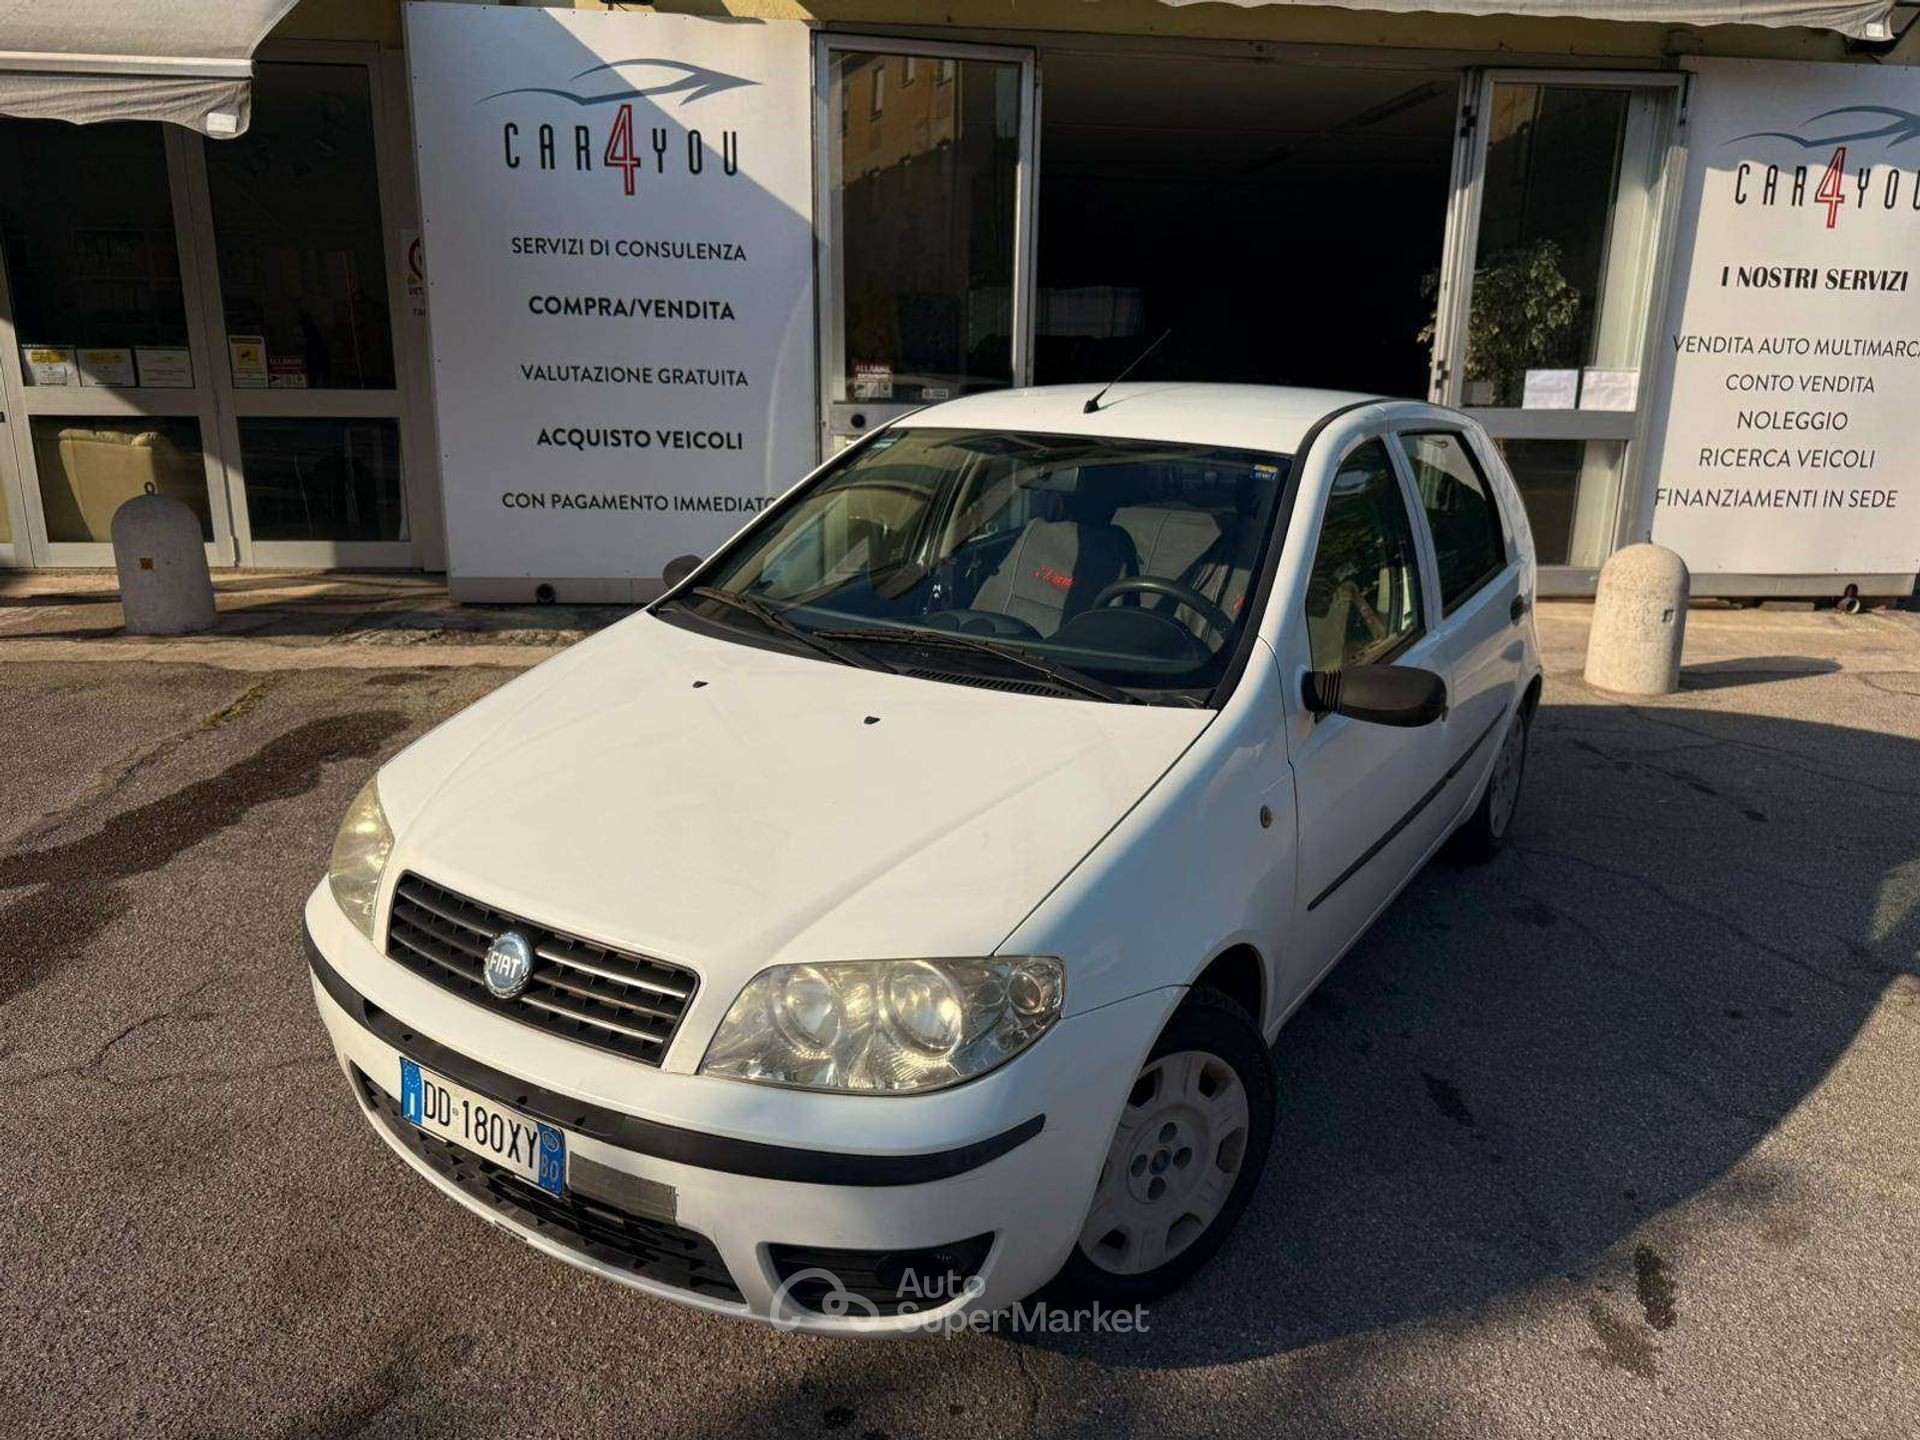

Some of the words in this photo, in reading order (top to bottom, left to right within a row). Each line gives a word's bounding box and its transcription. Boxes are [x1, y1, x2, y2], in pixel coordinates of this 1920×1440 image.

[504, 103, 739, 196] CAR4YOU
[511, 236, 585, 256] SERVIZI
[590, 239, 611, 256] DI
[615, 240, 747, 261] CONSULENZA
[1721, 266, 1730, 287] I
[1736, 266, 1818, 290] NOSTRI
[1825, 268, 1909, 292] SERVIZI
[528, 295, 735, 321] COMPRA/VENDITA
[1672, 335, 1754, 354] VENDITA
[1757, 337, 1810, 355] AUTO
[1813, 339, 1920, 358] MULTIMARC
[520, 364, 653, 384] VALUTAZIONE
[657, 367, 749, 387] GRATUITA
[1725, 373, 1794, 392] CONTO
[1798, 375, 1875, 394] VENDITA
[1736, 410, 1848, 431] NOLEGGIO
[536, 427, 652, 452] ACQUISTO
[656, 430, 743, 451] VEICOLI
[1698, 448, 1791, 468] RICERCA
[1796, 449, 1875, 469] VEICOLI
[502, 492, 545, 509] CON
[550, 493, 670, 512] PAGAMENTO
[1654, 487, 1818, 508] FINANZIAMENTI
[1822, 489, 1845, 508] IN
[1848, 489, 1898, 508] SEDE
[489, 951, 521, 979] FIAT
[424, 1080, 450, 1127] DD
[462, 1100, 538, 1169] 180XY
[541, 1154, 559, 1182] BO
